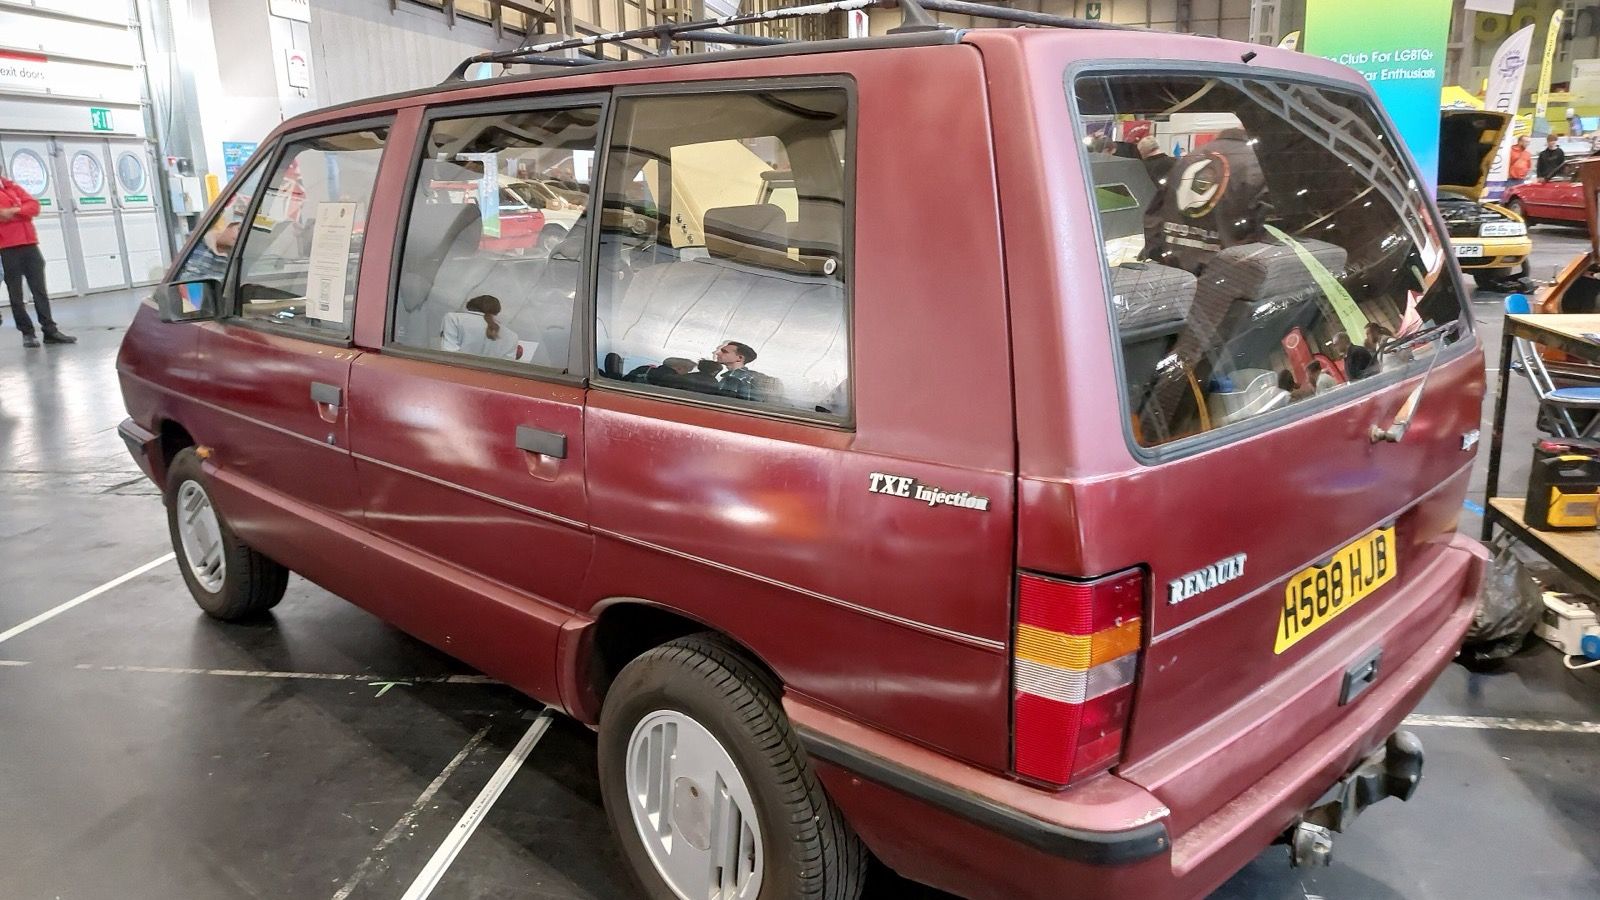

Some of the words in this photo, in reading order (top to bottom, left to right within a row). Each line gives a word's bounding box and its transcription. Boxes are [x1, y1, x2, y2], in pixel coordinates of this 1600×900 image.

[1340, 51, 1368, 65] Club
[1372, 51, 1392, 62] For
[1395, 49, 1434, 61] LGBTQ+
[0, 66, 17, 77] exit
[20, 67, 45, 79] doors
[1381, 67, 1436, 80] Enthusiasts
[1460, 246, 1479, 255] GPR
[869, 472, 914, 498] TXE
[915, 485, 989, 511] Injection
[1168, 553, 1247, 605] RENAULT
[1284, 561, 1344, 640] H588
[1349, 534, 1388, 598] HJB
